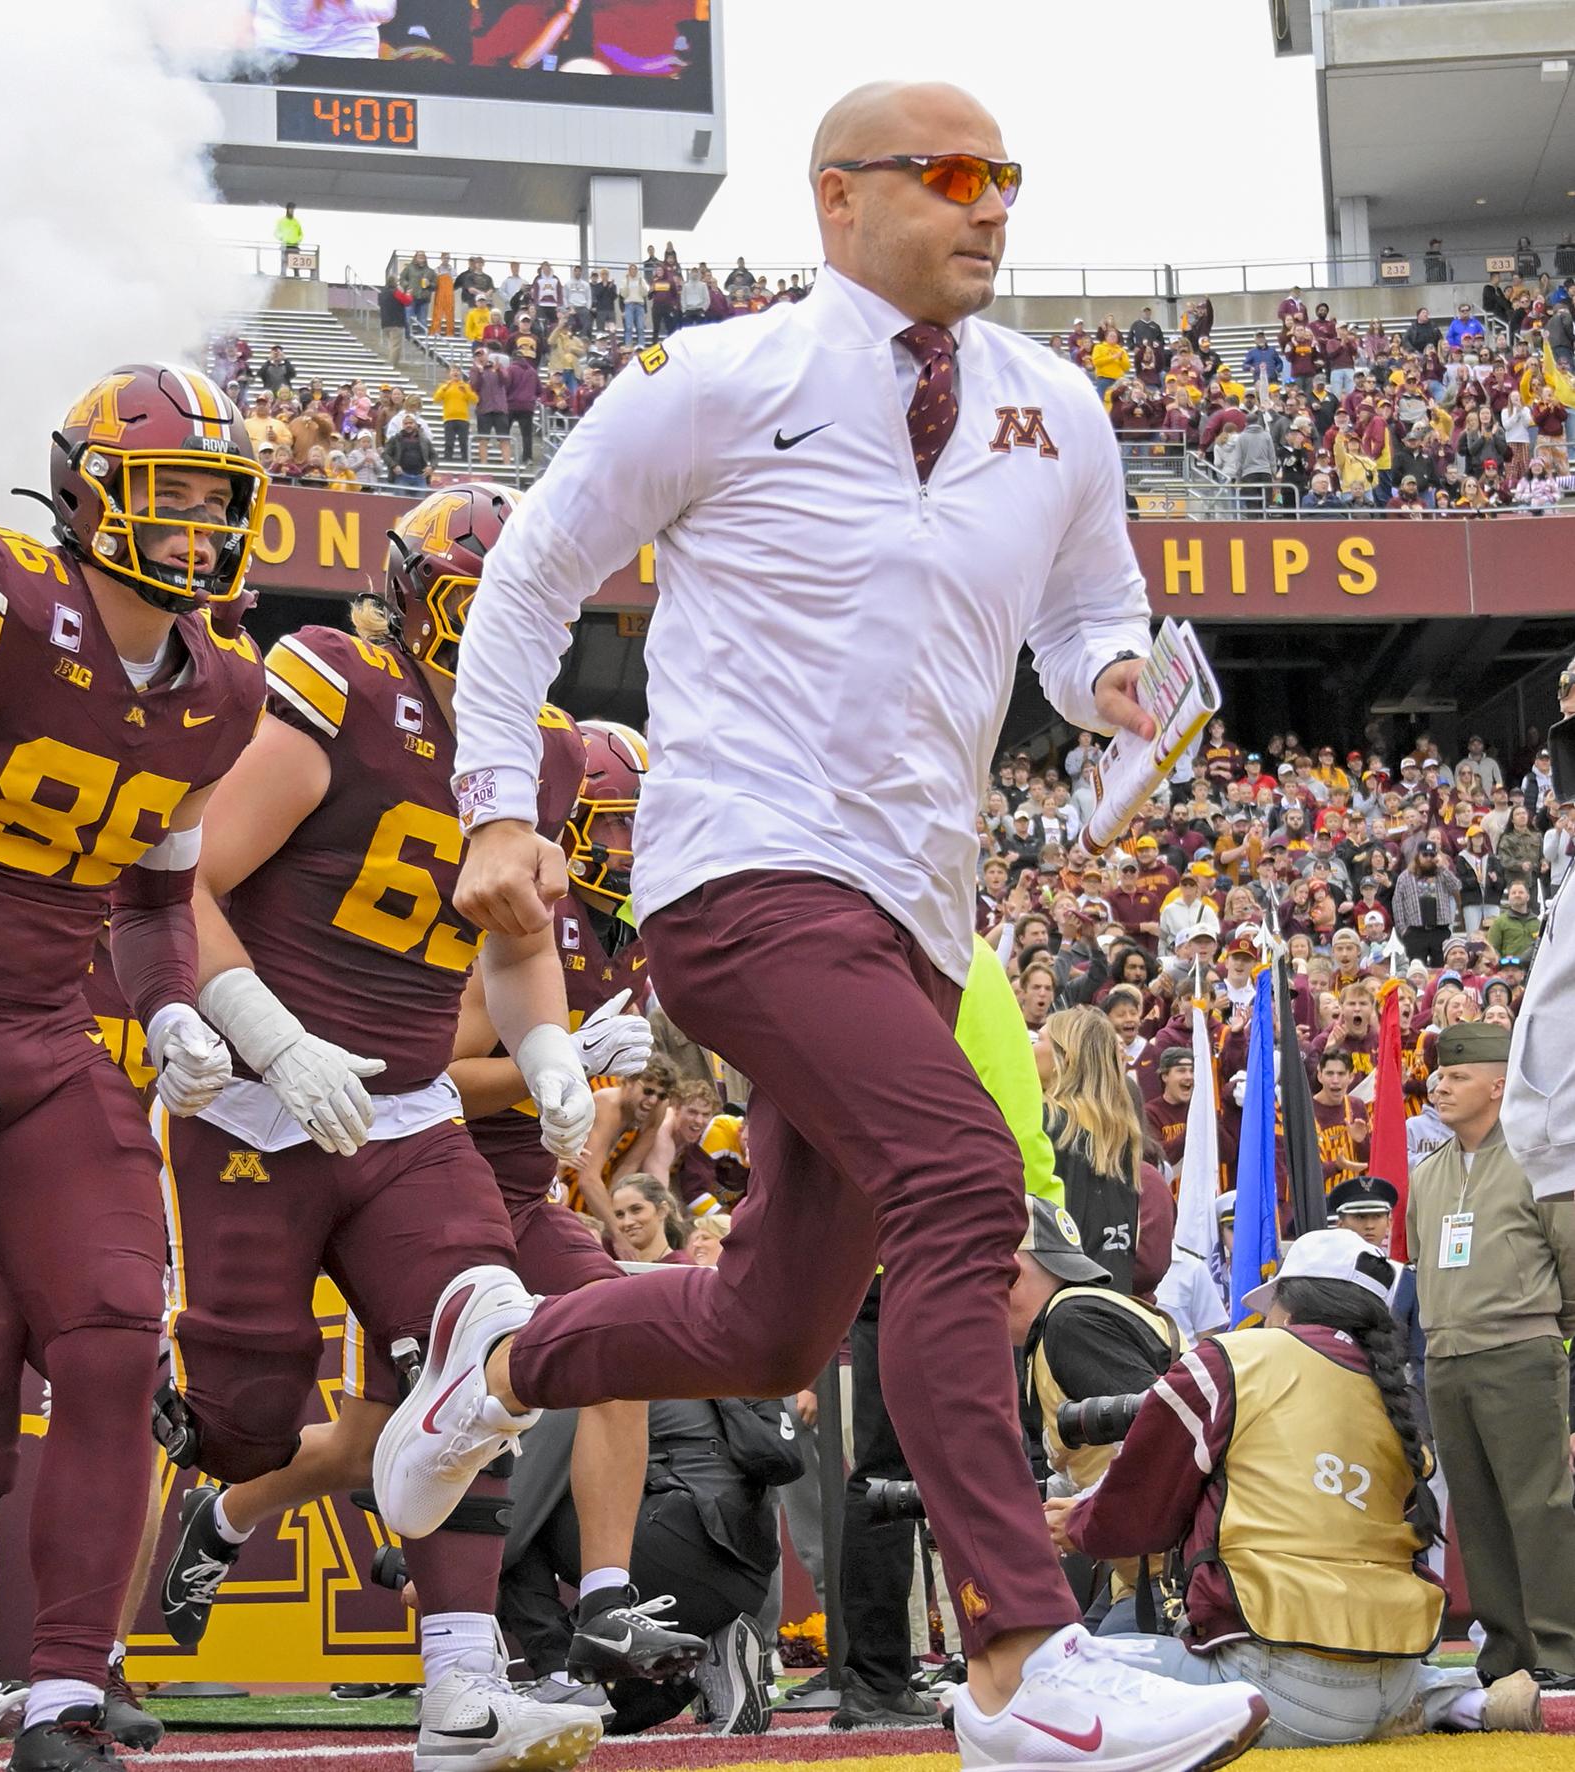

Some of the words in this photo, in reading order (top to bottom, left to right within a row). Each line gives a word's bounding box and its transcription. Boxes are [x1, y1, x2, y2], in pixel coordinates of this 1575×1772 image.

[313, 98, 414, 143] 4:00
[292, 255, 313, 267] 230
[1491, 260, 1511, 269] 233
[202, 438, 229, 453] ROW
[1102, 1222, 1132, 1251] 25
[1312, 1451, 1372, 1512] 82
